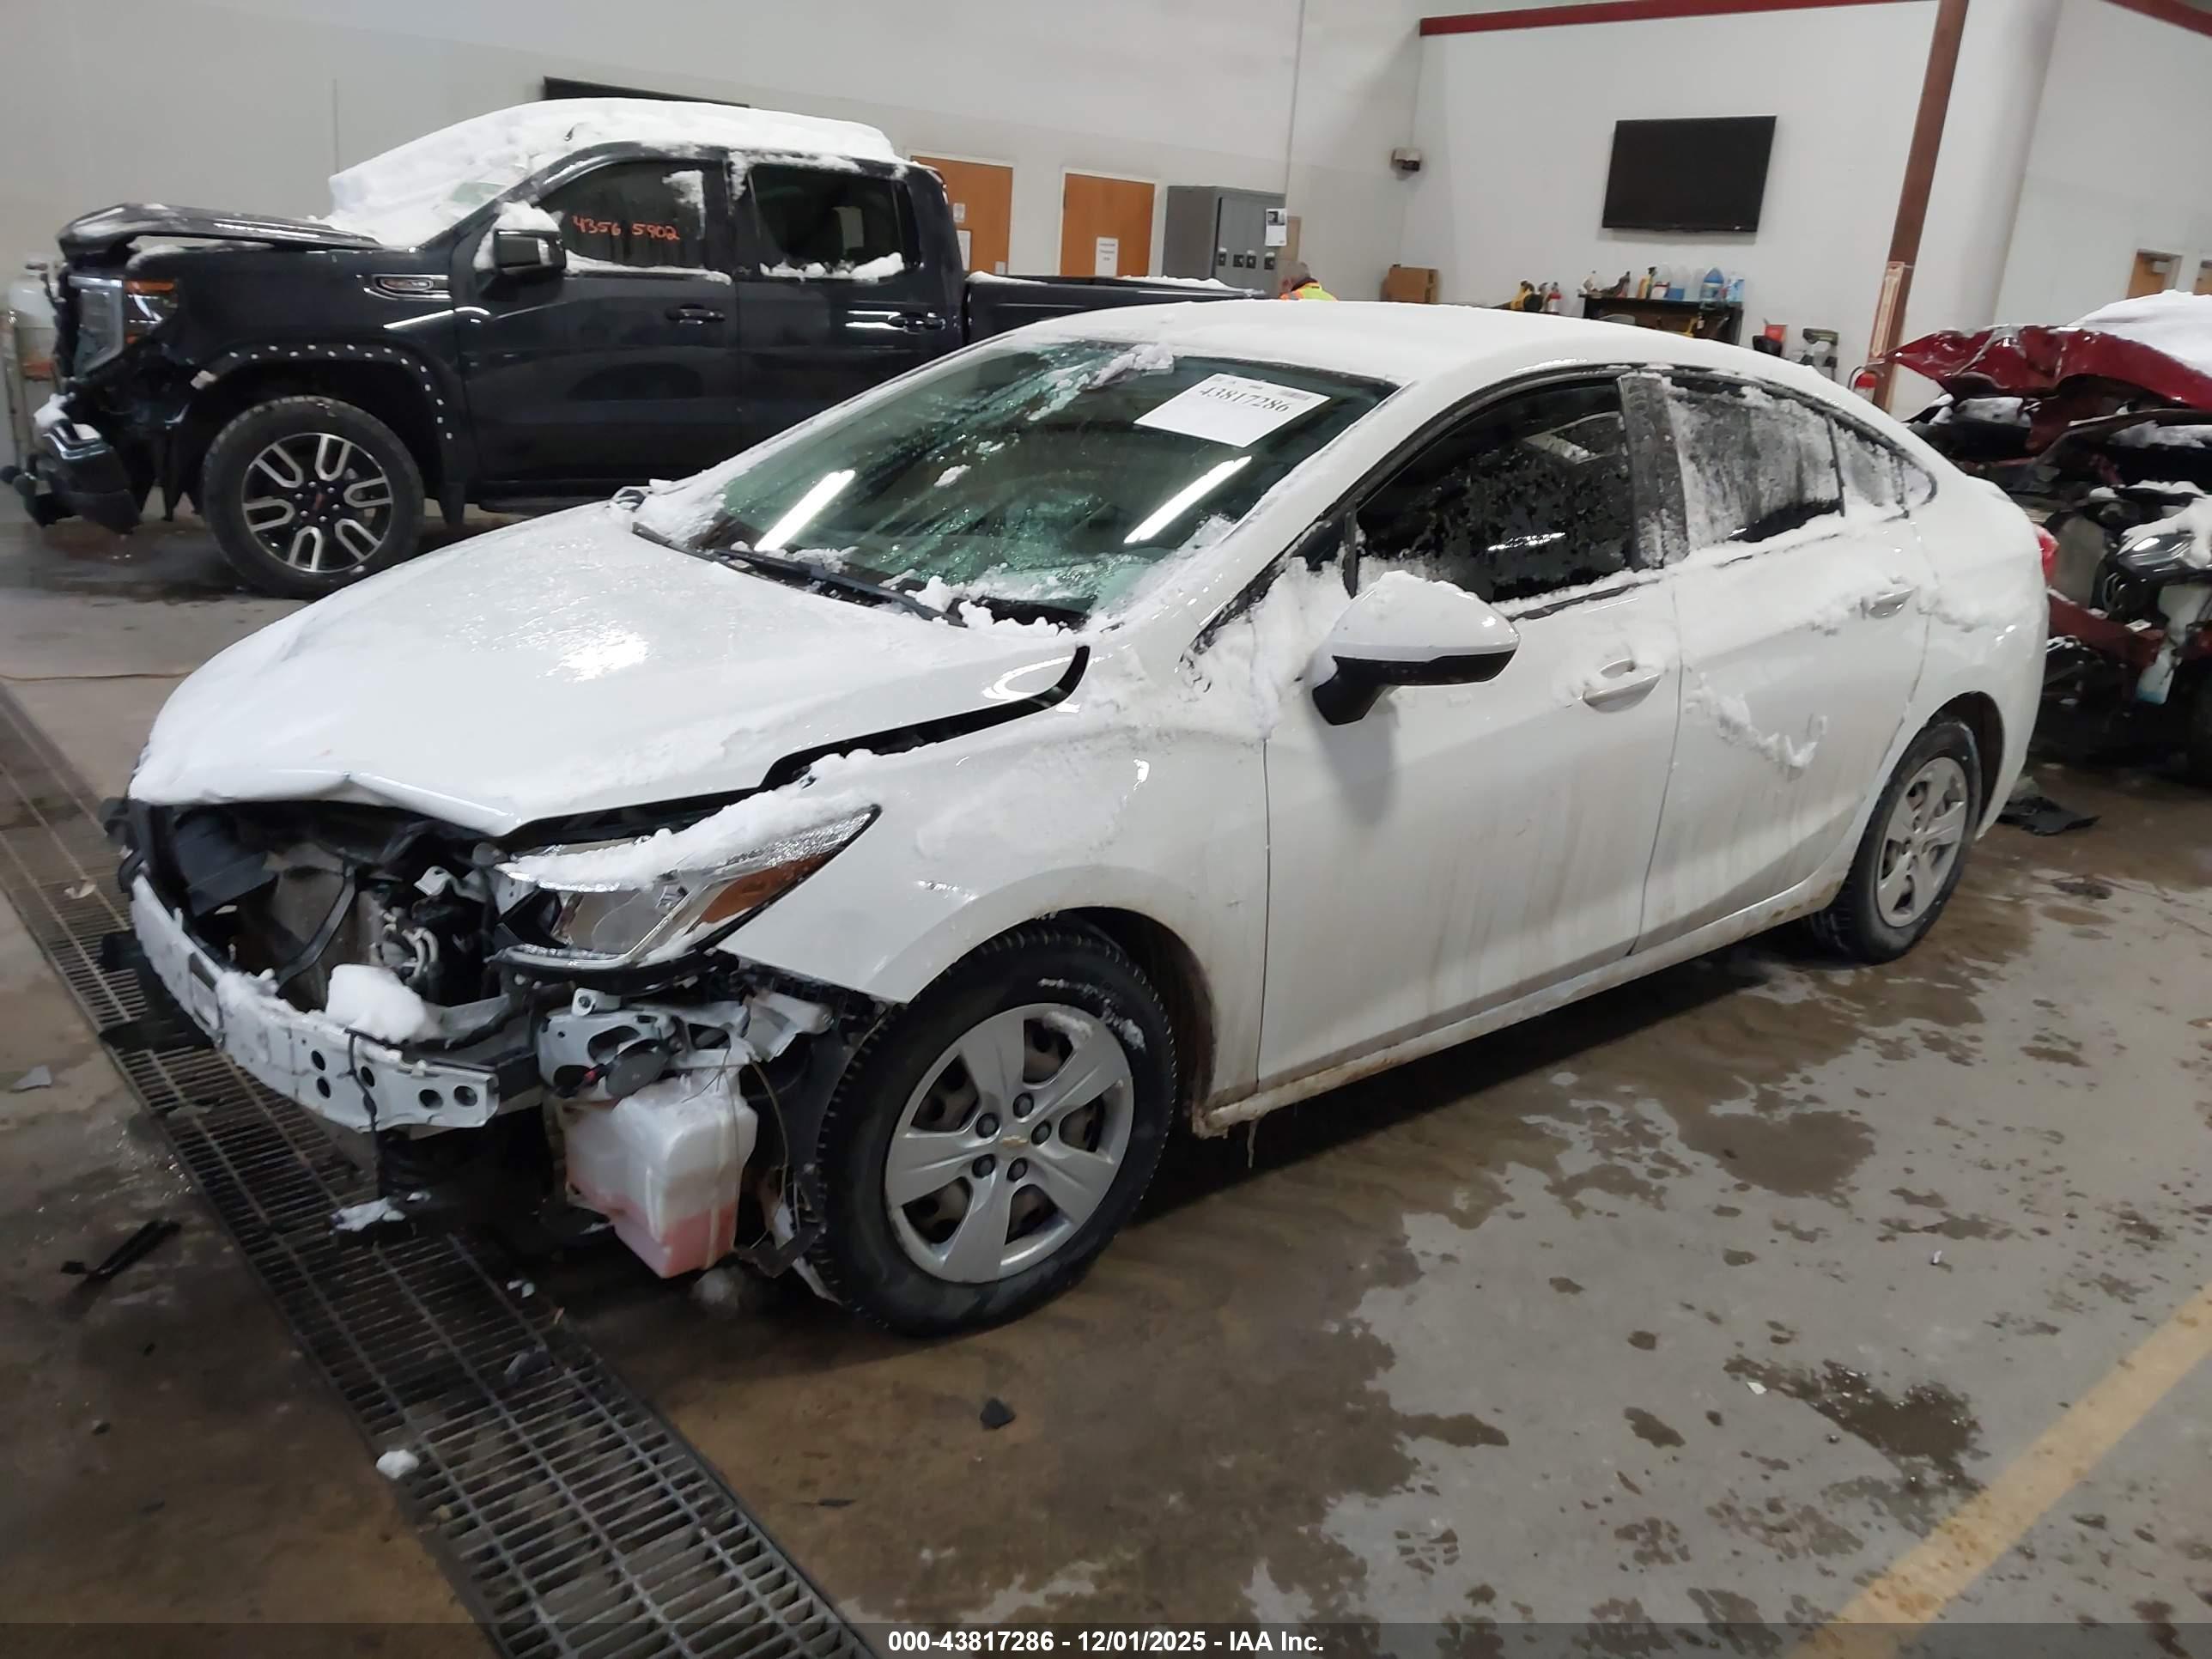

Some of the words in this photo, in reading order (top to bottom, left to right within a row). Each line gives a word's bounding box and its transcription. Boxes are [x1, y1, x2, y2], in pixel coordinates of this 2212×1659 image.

[572, 215, 621, 236] 4356
[631, 222, 680, 240] 5902
[1199, 386, 1290, 412] 43817286
